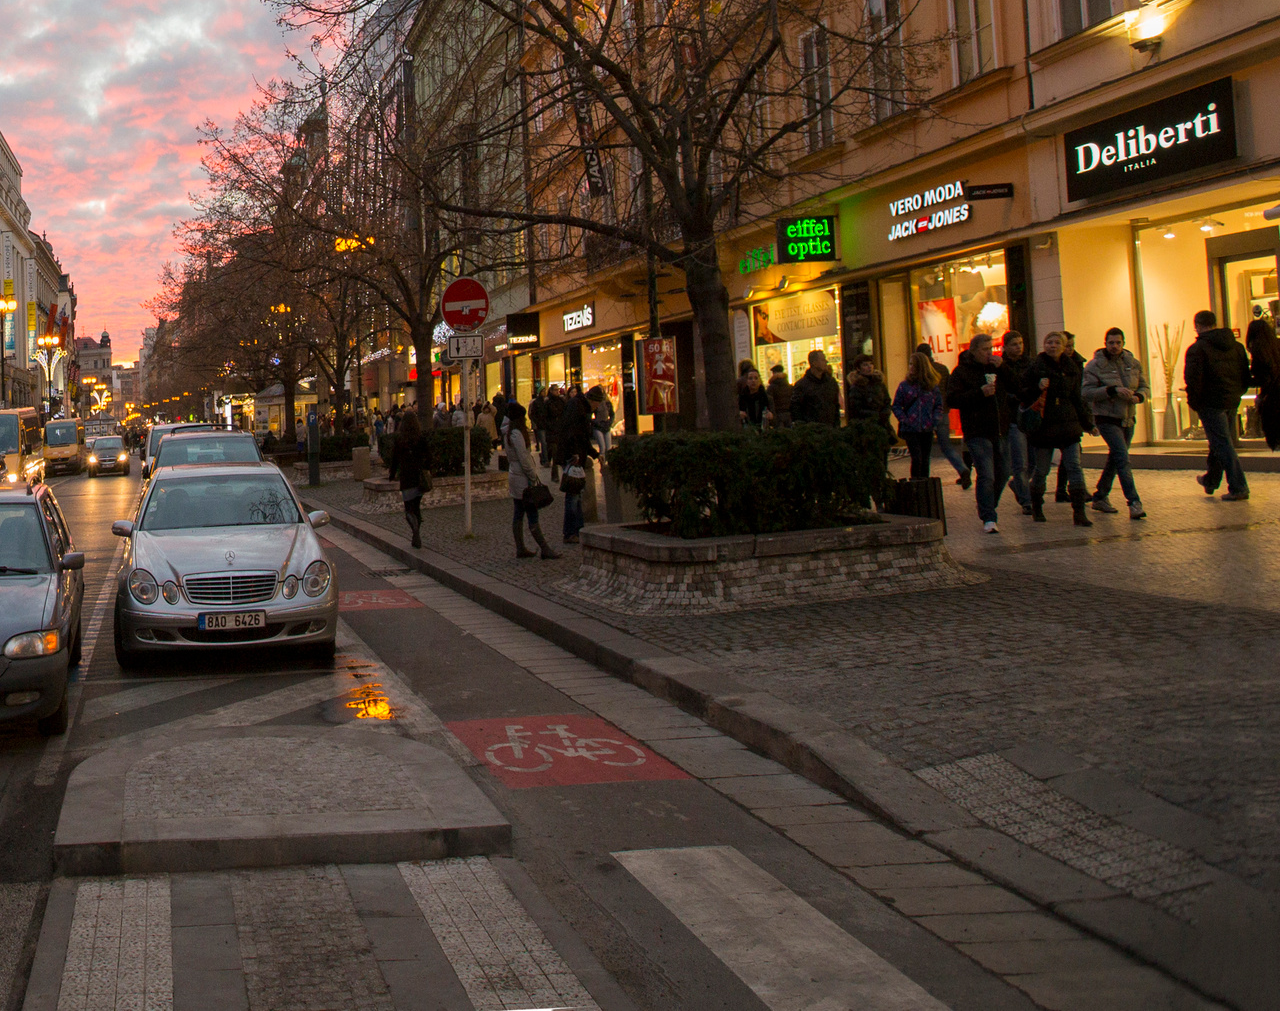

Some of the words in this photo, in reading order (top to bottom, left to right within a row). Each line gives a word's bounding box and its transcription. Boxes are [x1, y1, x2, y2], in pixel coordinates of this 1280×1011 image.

[1074, 102, 1221, 175] Deliberti
[1124, 157, 1157, 173] ITALIA
[889, 193, 922, 217] VERO
[923, 180, 964, 208] MODA
[786, 218, 830, 238] eiffel
[888, 218, 918, 241] JACK
[927, 203, 970, 230] JONES
[739, 243, 775, 274] eiffel
[787, 237, 831, 260] optic
[562, 304, 593, 332] TEZENIS
[774, 308, 786, 321] EYE
[776, 319, 805, 334] CONTACT
[806, 316, 830, 329] LENSES
[648, 343, 661, 353] 50
[922, 333, 954, 354] ALE
[309, 414, 315, 423] P
[234, 613, 260, 627] 6426
